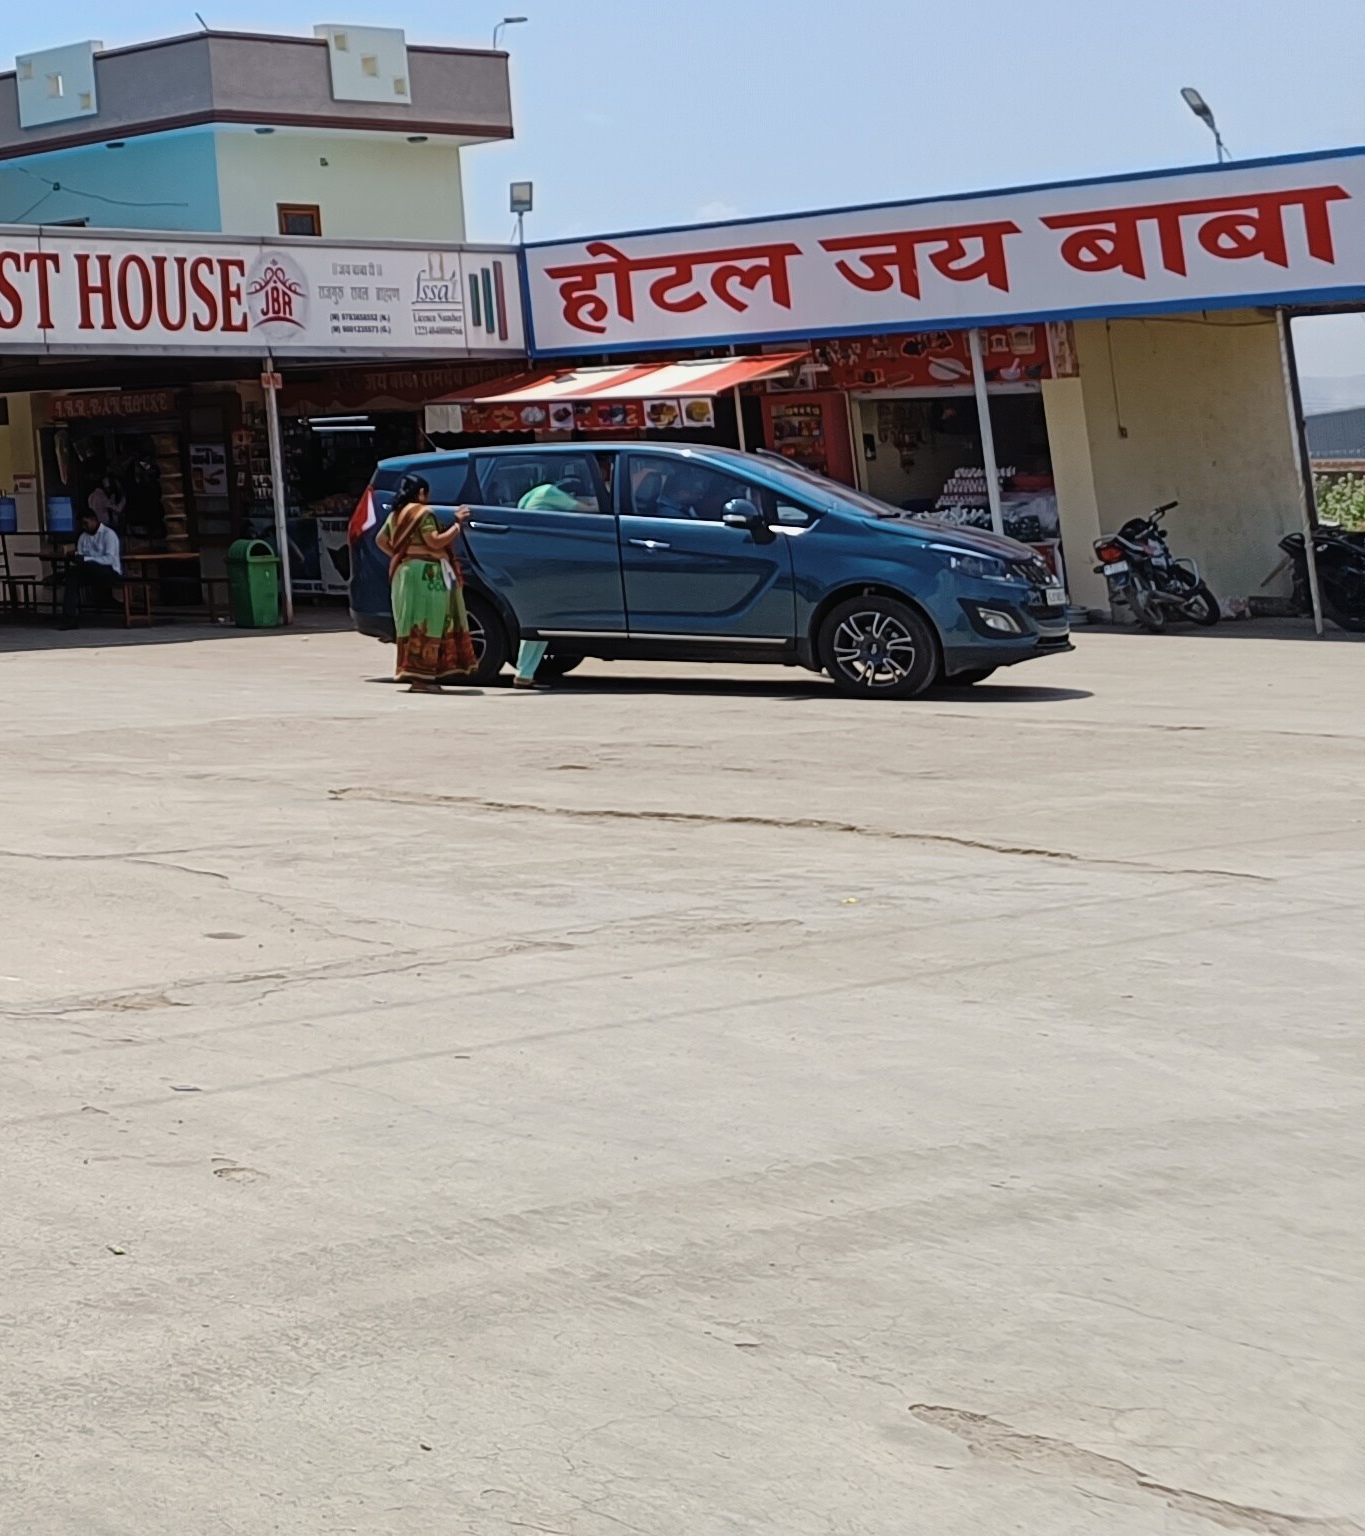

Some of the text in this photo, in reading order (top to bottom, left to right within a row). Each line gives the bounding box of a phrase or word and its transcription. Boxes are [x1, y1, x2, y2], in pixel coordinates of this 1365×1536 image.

[74, 253, 248, 332] HOUSE
[544, 185, 1351, 333] होटल जय बाबा
[261, 286, 293, 316] JBR
